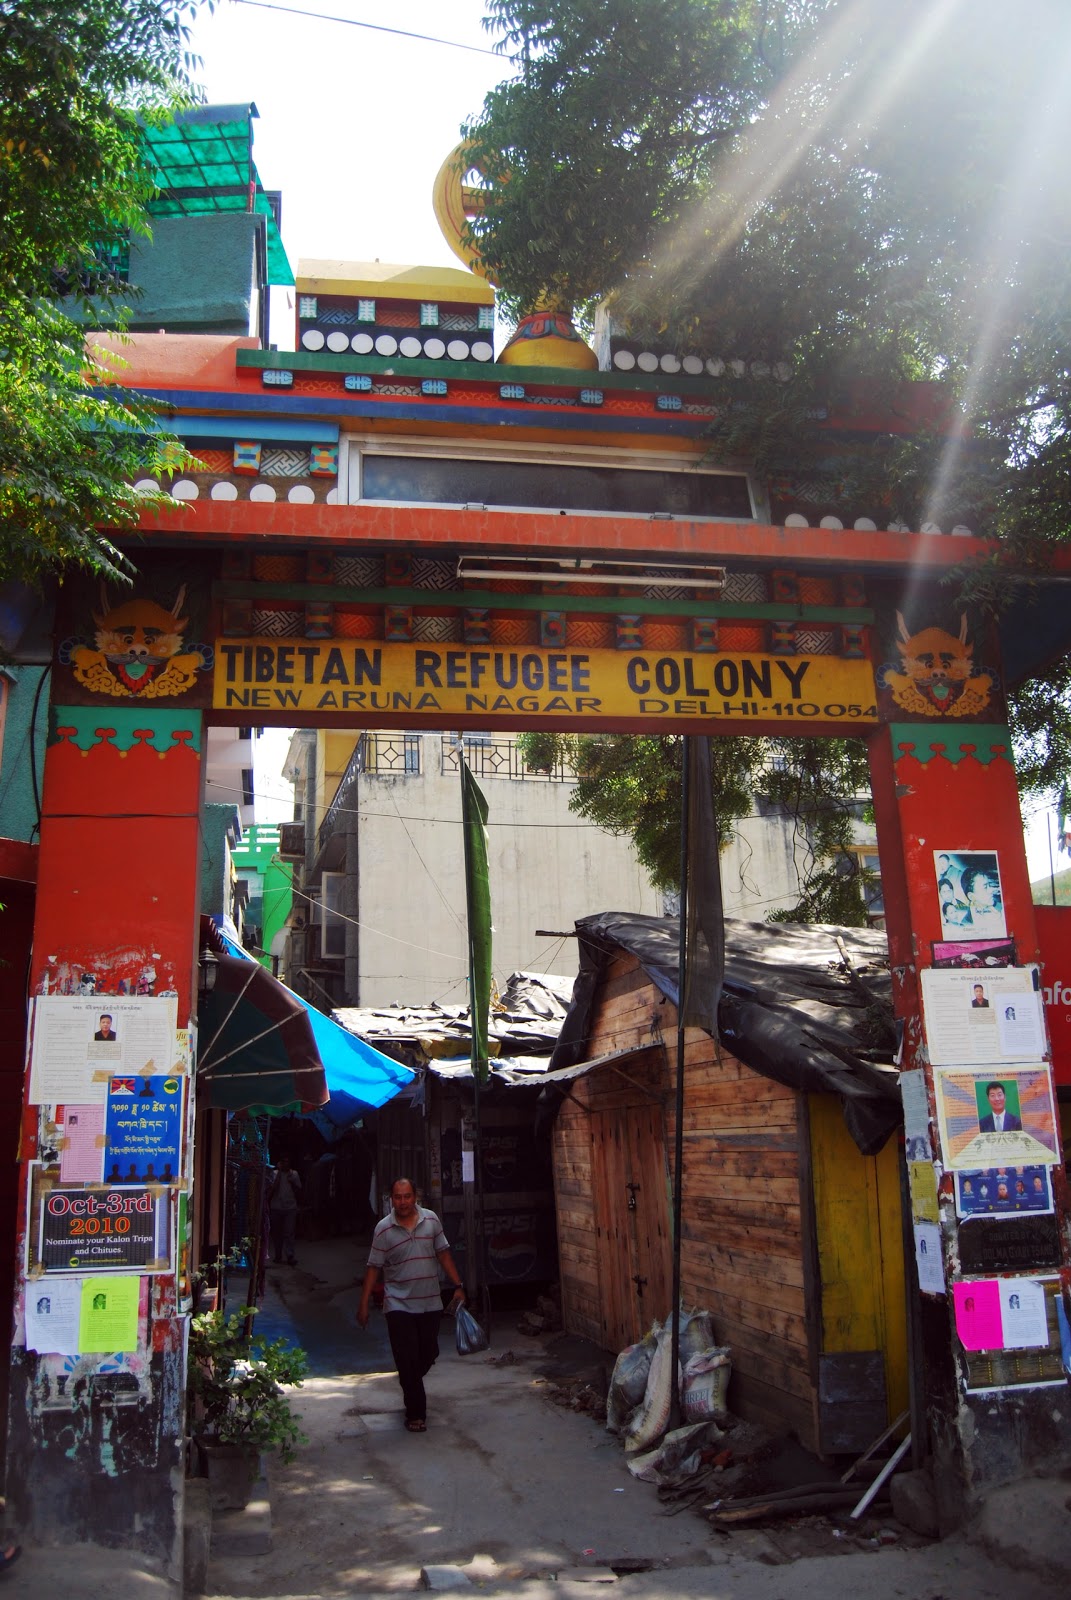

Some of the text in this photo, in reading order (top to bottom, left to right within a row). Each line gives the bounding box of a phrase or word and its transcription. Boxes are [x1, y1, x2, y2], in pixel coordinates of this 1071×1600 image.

[221, 644, 811, 699] TIBETAN REFUGEE COLONY
[225, 688, 303, 708] NEW
[316, 690, 442, 711] ARUNA
[465, 694, 602, 713] NAGAR
[48, 1193, 153, 1215] Oct-3rd
[70, 1216, 131, 1235] 2010
[45, 1236, 84, 1246] Nominate
[86, 1238, 105, 1246] your
[106, 1235, 130, 1244] Kalon
[74, 1246, 124, 1255] and Chitues.
[683, 1391, 706, 1404] HREE
